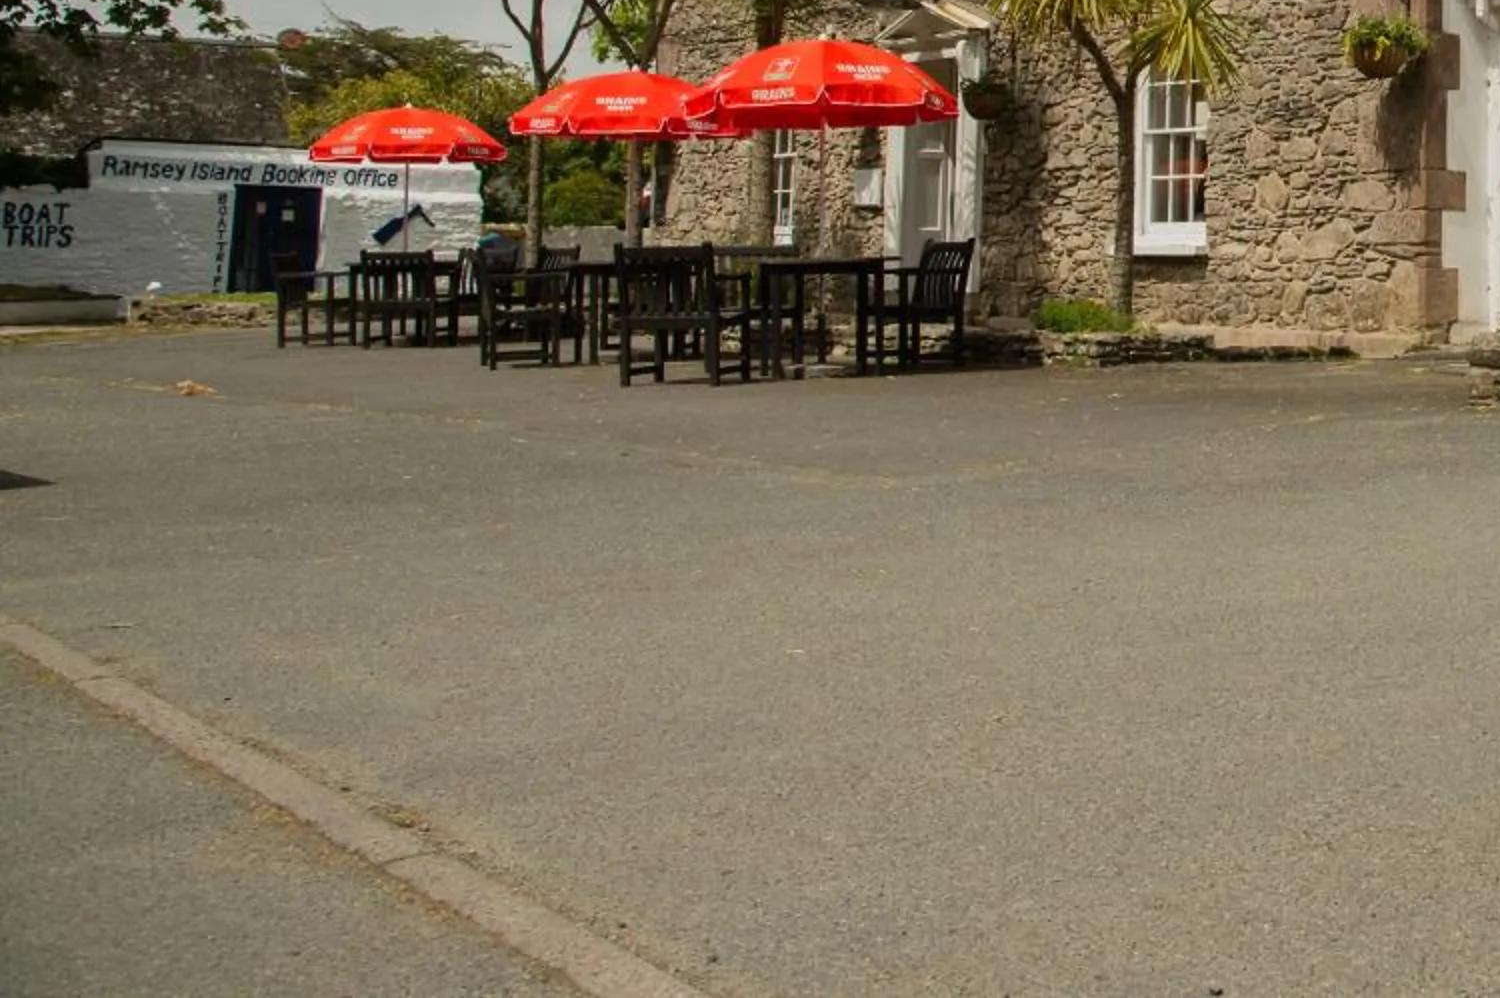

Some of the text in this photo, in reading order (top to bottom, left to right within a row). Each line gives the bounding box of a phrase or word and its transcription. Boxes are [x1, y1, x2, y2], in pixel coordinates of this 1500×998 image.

[261, 163, 337, 187] Booking
[343, 167, 399, 188] Office
[4, 202, 71, 224] BOAT
[3, 224, 75, 249] TRIPS
